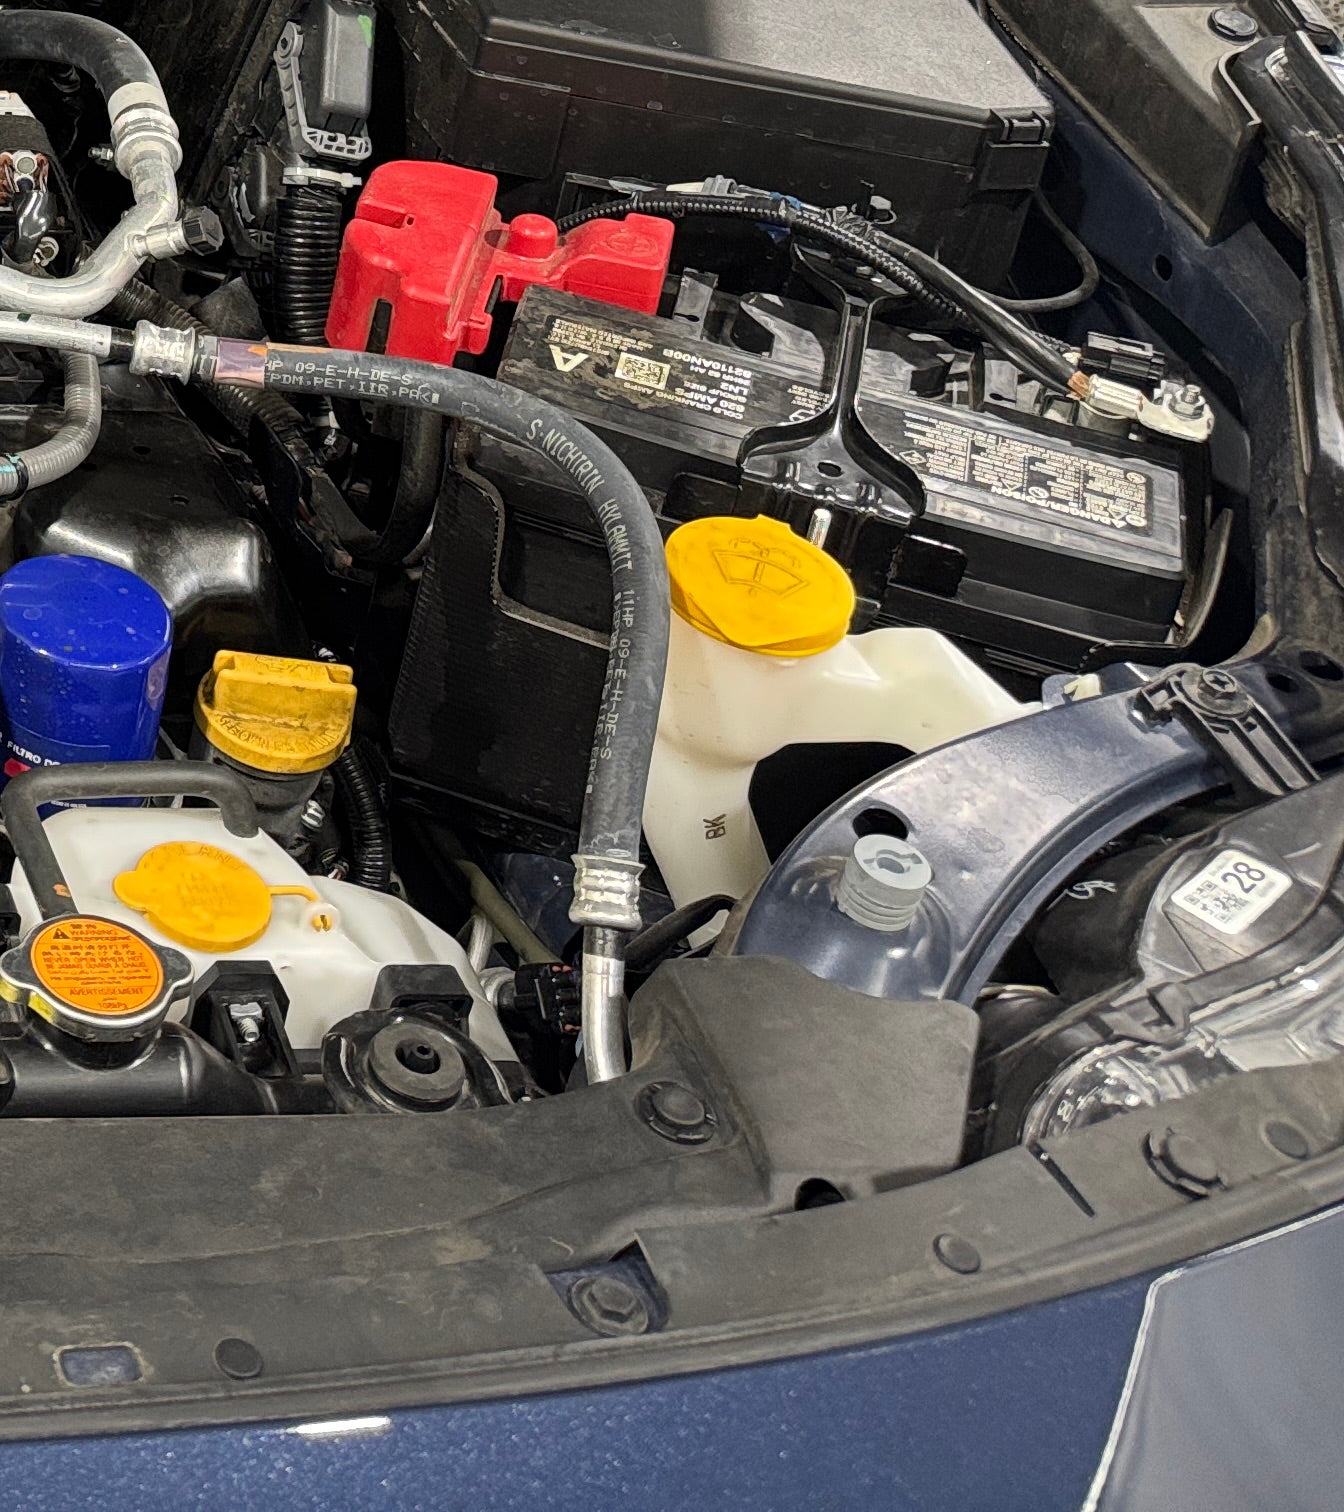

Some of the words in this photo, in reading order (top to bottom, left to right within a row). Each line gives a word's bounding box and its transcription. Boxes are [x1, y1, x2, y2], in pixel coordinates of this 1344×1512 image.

[549, 344, 590, 372] A
[295, 361, 413, 386] 09-E-H-DE-S
[674, 387, 718, 405] AMPS
[720, 382, 749, 396] LN2
[7, 740, 42, 764] FILTRO
[703, 813, 727, 840] BK
[1221, 862, 1266, 894] 28
